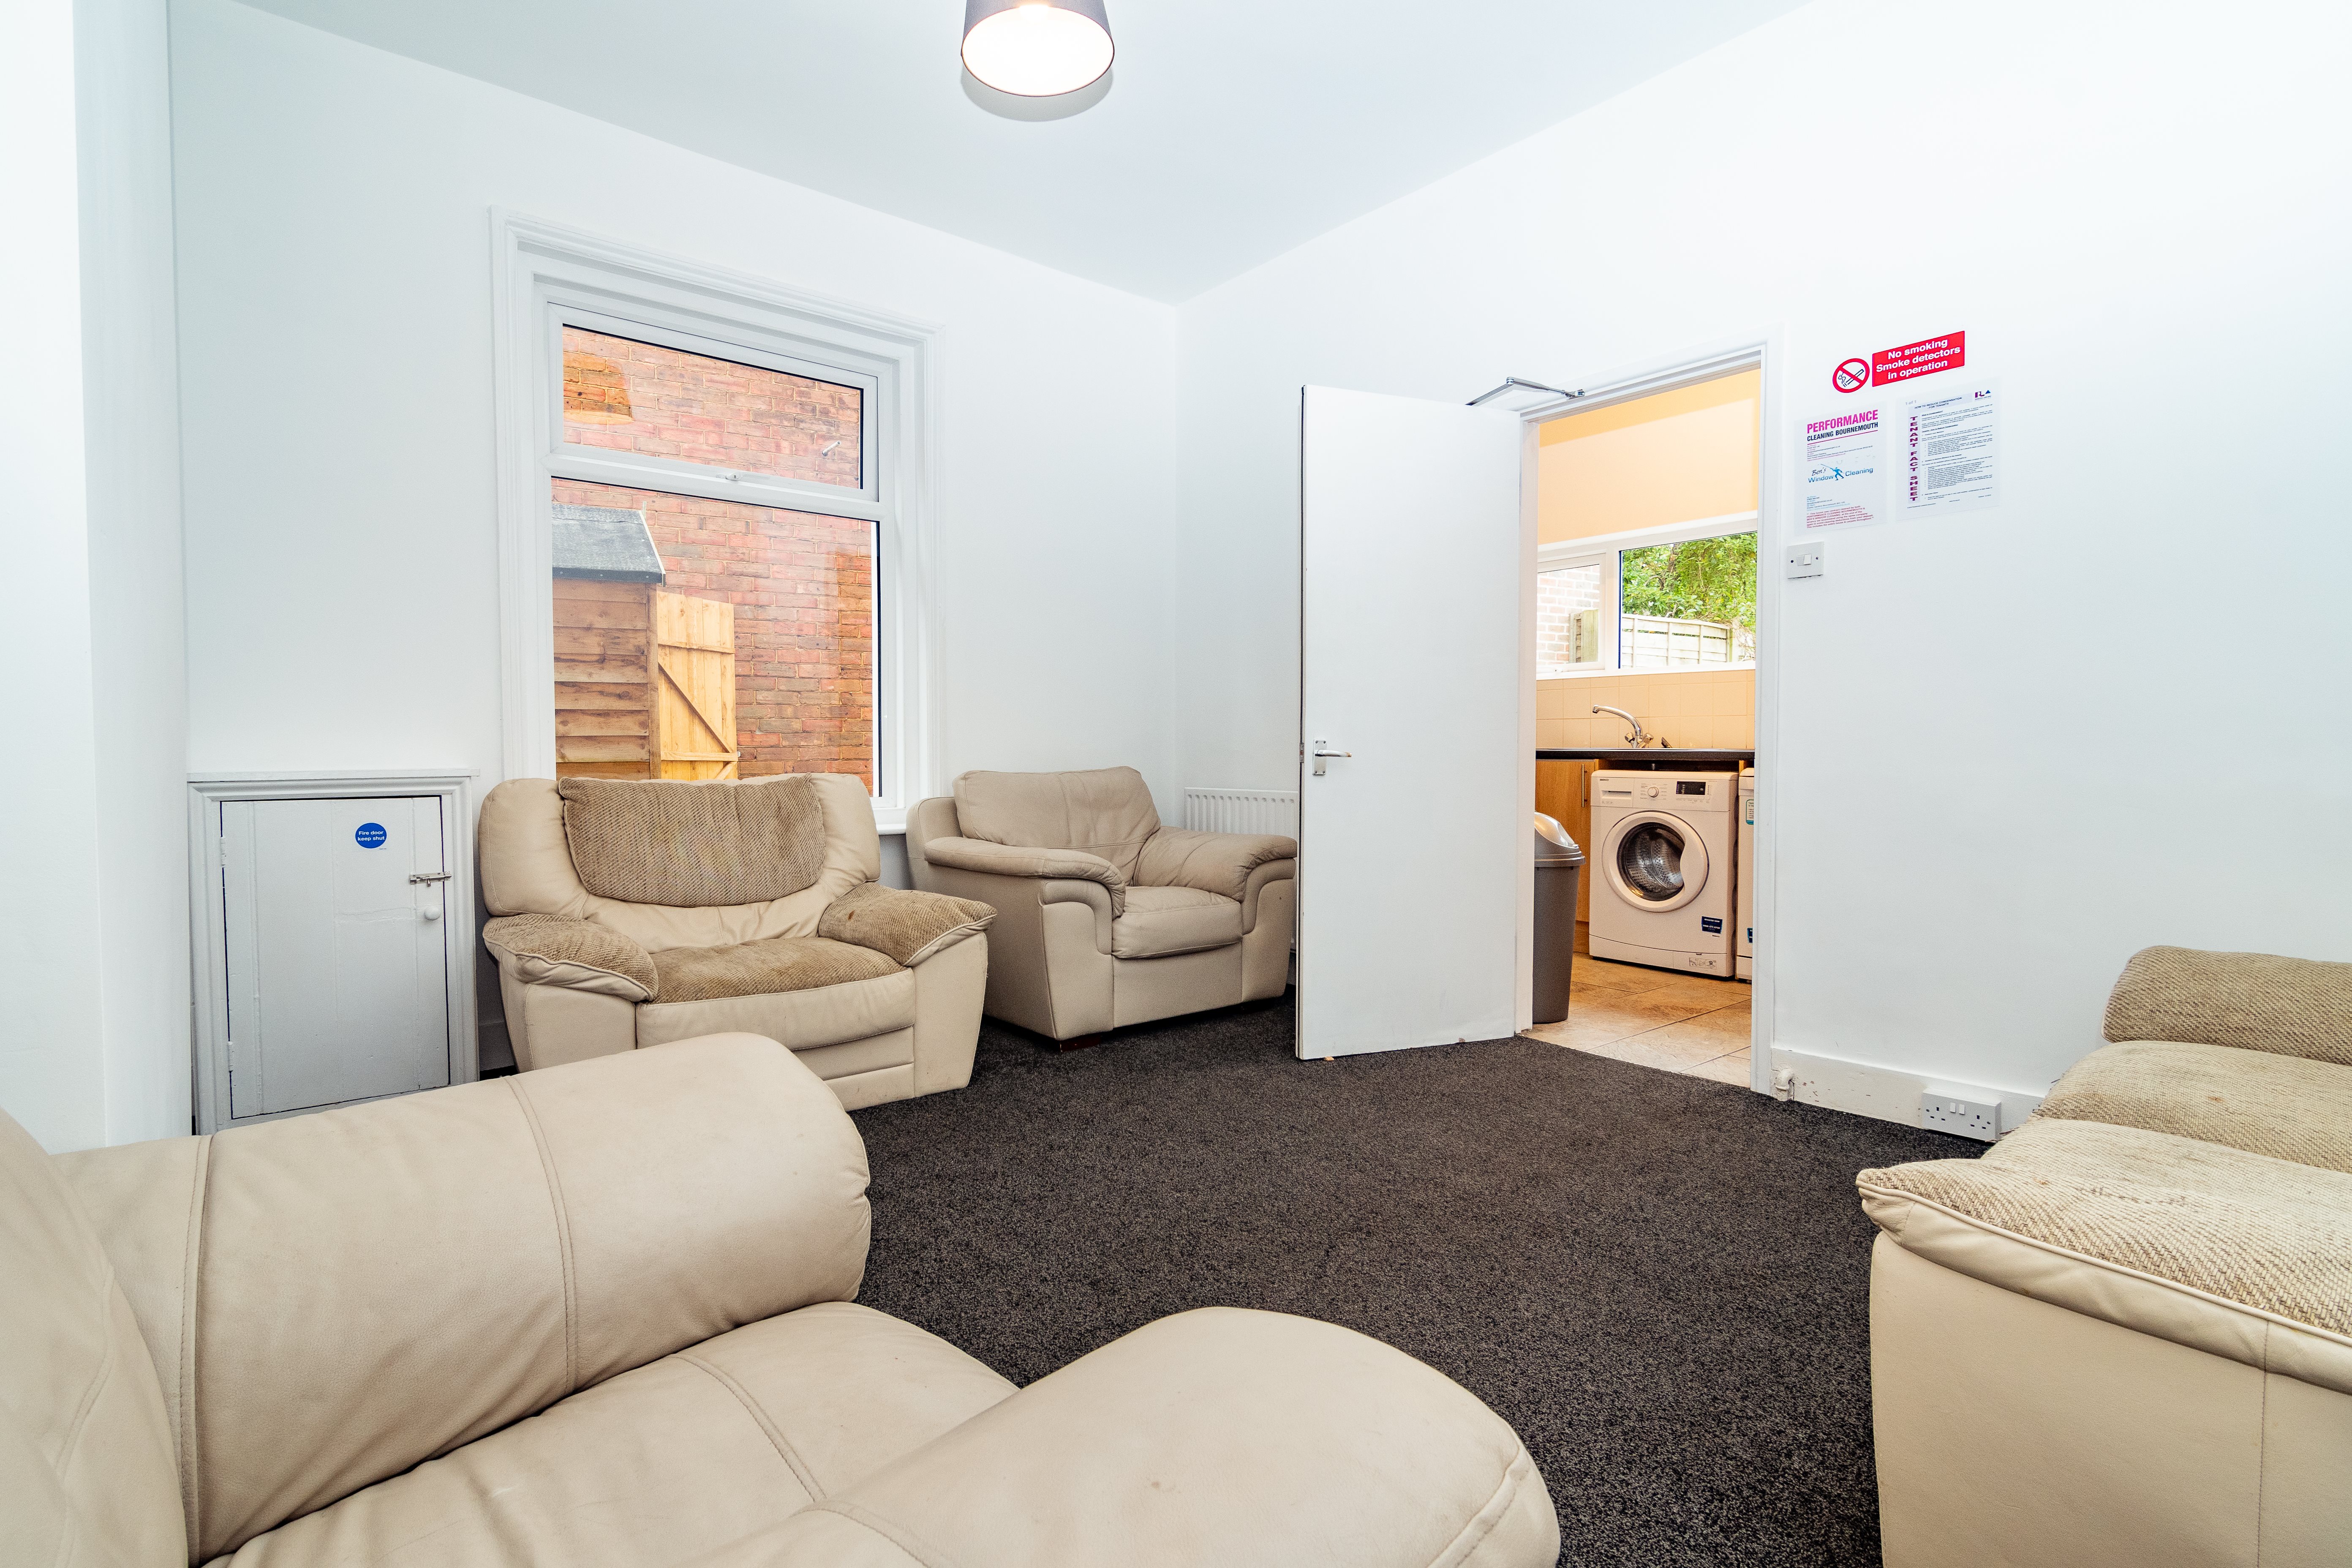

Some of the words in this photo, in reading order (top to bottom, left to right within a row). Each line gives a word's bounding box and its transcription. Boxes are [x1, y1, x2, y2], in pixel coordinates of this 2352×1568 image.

[1888, 351, 1902, 359] No
[1904, 339, 1948, 356] smoking
[1876, 359, 1910, 372] Smoke
[1912, 347, 1960, 364] detectors
[1900, 360, 1948, 377] operation
[1807, 409, 1878, 434] PERFORMANCE
[1807, 431, 1834, 441] CLEANING
[1835, 422, 1878, 436] BOURNEMOUTH
[1910, 416, 1919, 447] TENANT
[1812, 467, 1827, 476] Ben's
[1910, 451, 1918, 472] FACT
[1808, 474, 1834, 483] Window
[1845, 468, 1873, 476] Cleaning
[1910, 475, 1918, 501] SHEET
